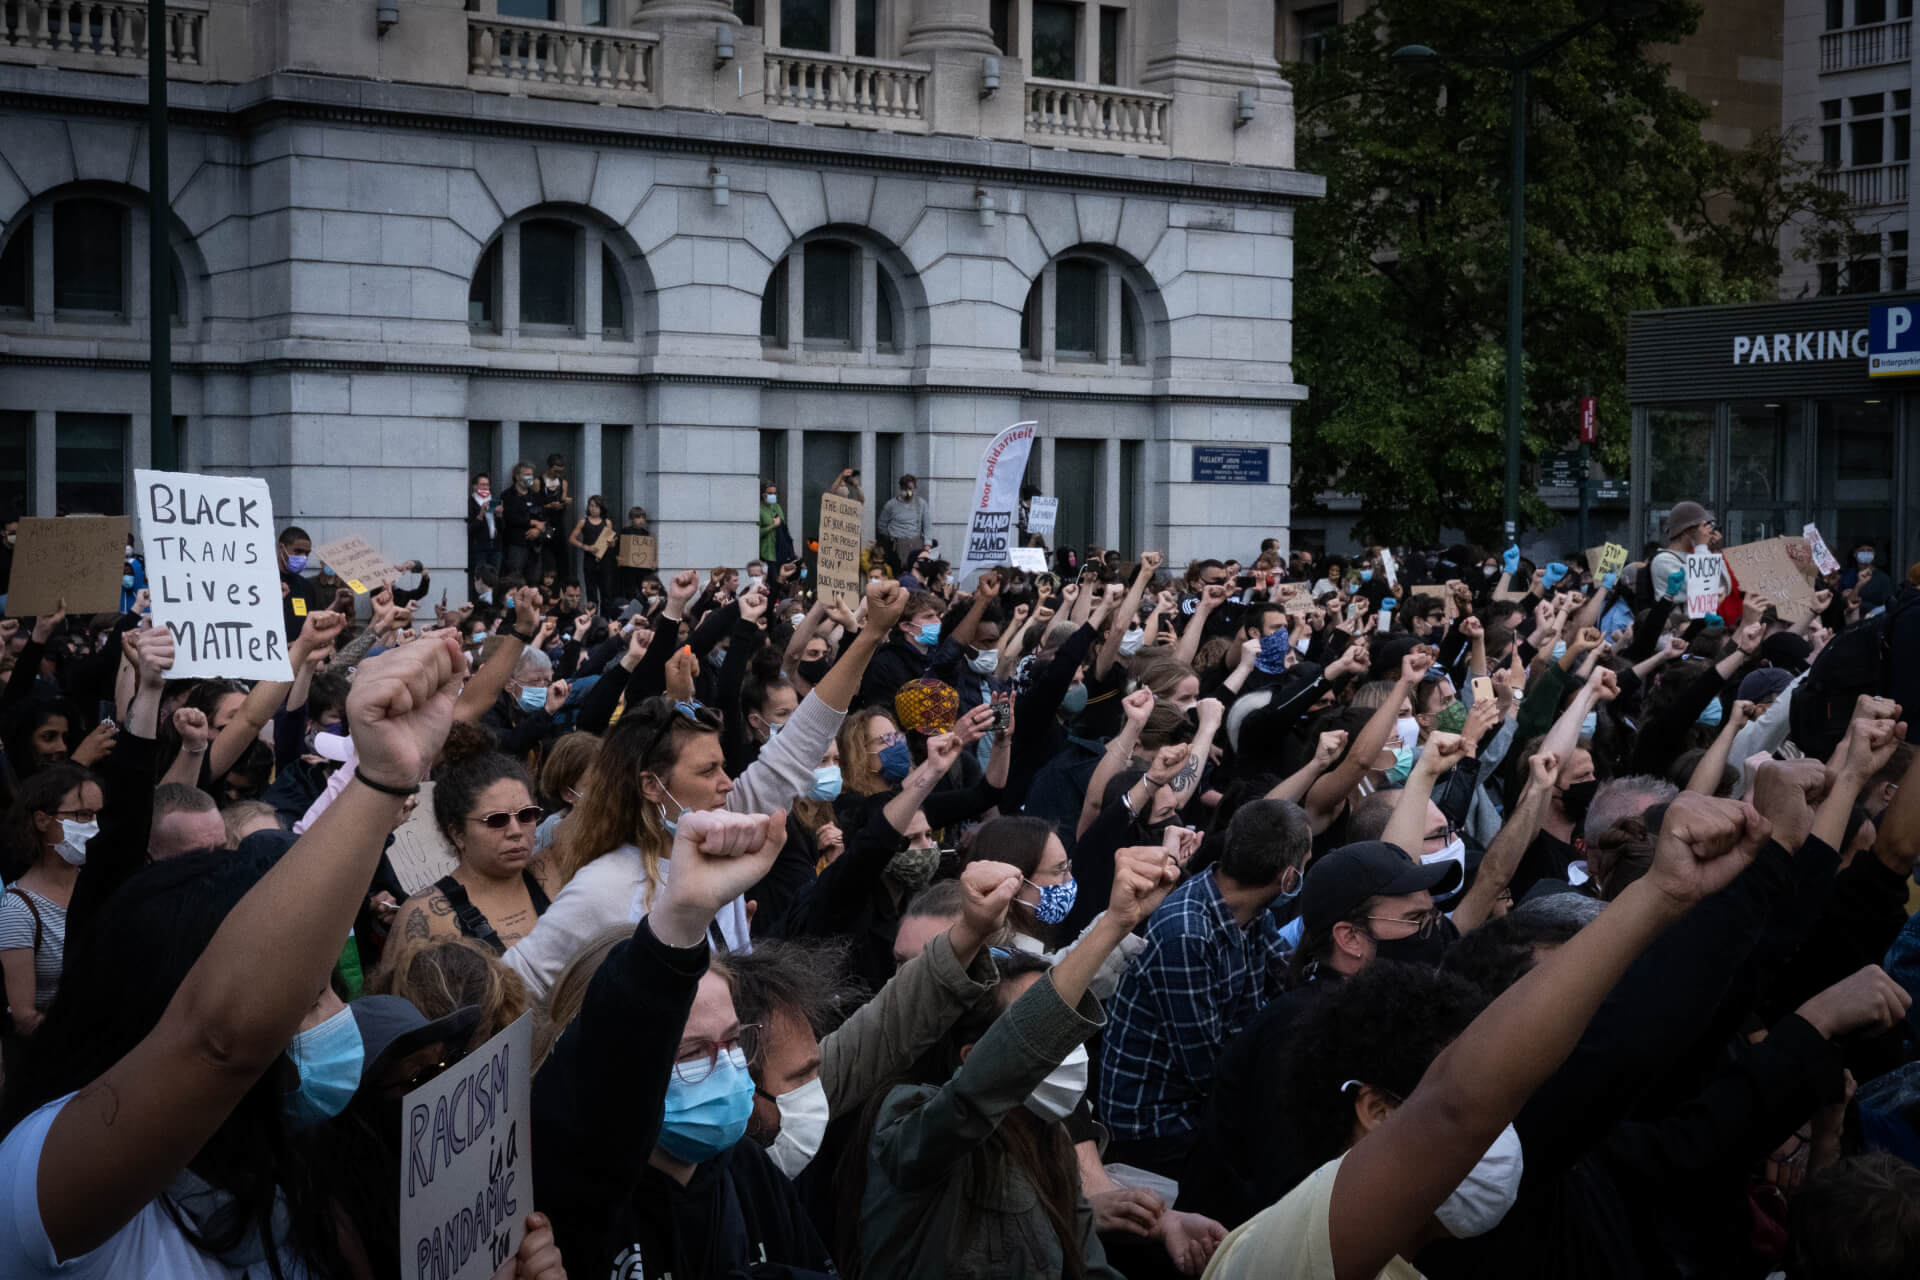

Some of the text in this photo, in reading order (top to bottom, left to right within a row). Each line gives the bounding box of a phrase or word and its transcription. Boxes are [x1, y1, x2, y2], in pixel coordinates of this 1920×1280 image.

[1733, 328, 1868, 365] PARKING
[1887, 306, 1912, 350] P
[980, 426, 1033, 509] voor solidariteit
[150, 483, 260, 529] BLACK
[974, 513, 1009, 529] HAND
[153, 537, 258, 565] TRANS
[970, 536, 1007, 552] HAND
[162, 573, 261, 607] Lives
[1688, 558, 1721, 579] RACISM
[408, 1043, 509, 1199] RACISM
[489, 1119, 518, 1186] is a
[417, 1171, 517, 1280] PANDAMIC
[489, 1228, 512, 1274] too
